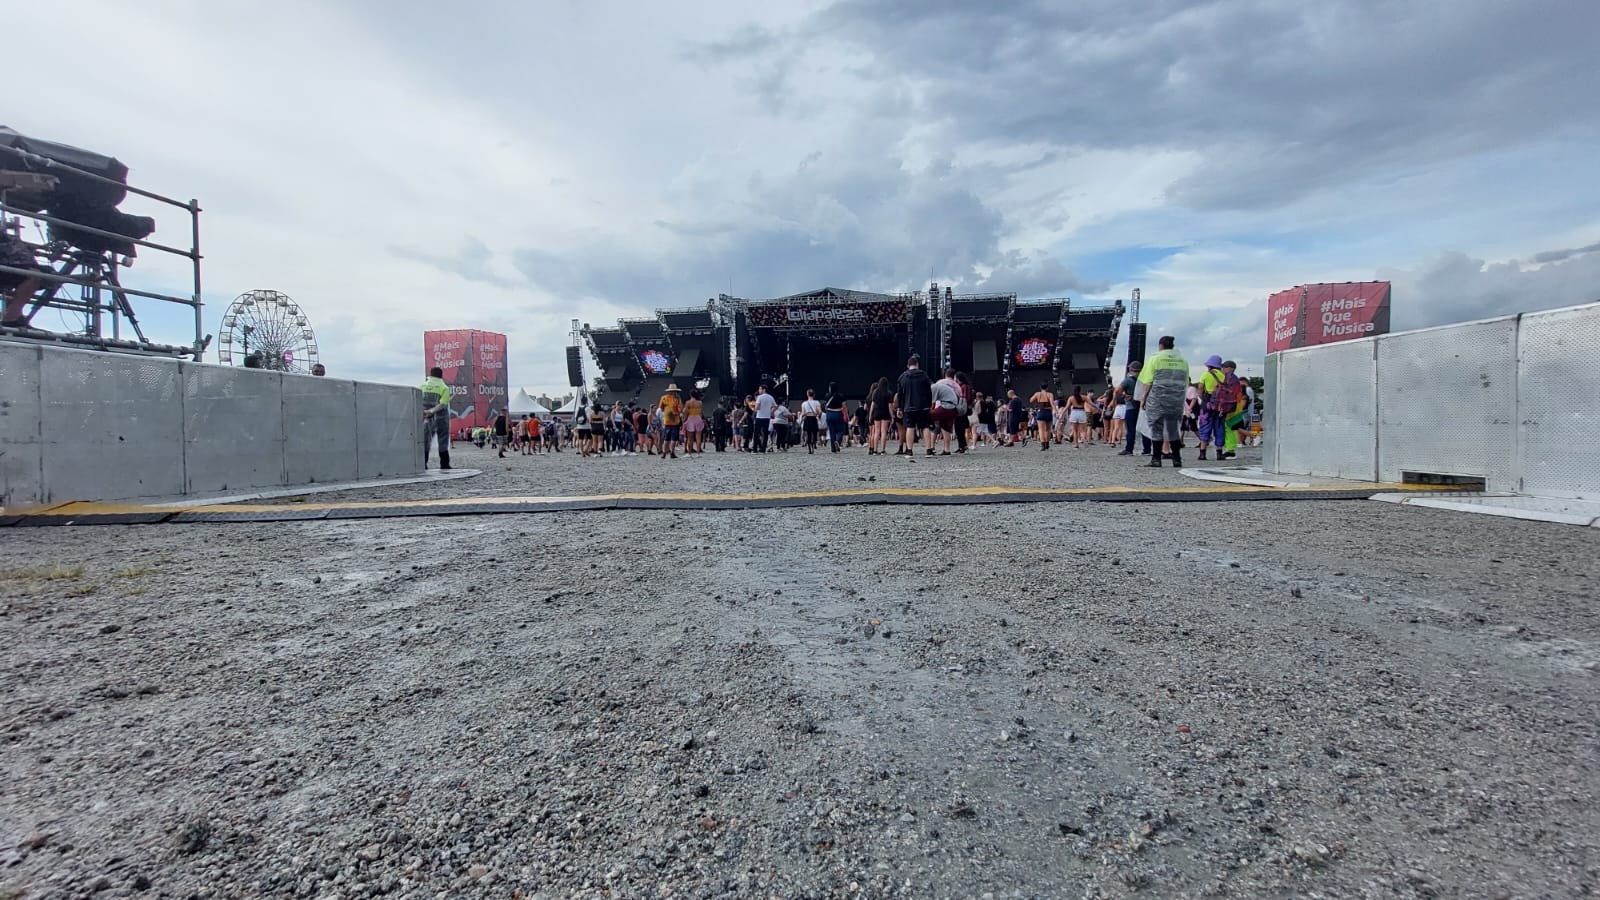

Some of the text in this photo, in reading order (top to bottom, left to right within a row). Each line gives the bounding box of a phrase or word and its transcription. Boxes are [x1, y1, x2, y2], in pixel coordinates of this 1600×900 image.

[1321, 297, 1366, 312] #Mais
[1322, 312, 1351, 324] Que
[1274, 318, 1287, 331] Que
[1322, 322, 1374, 336] Música
[1274, 326, 1296, 342] Música
[434, 352, 452, 361] Que
[480, 352, 493, 360] Que
[435, 359, 465, 369] Música
[479, 384, 504, 395] Doritos
